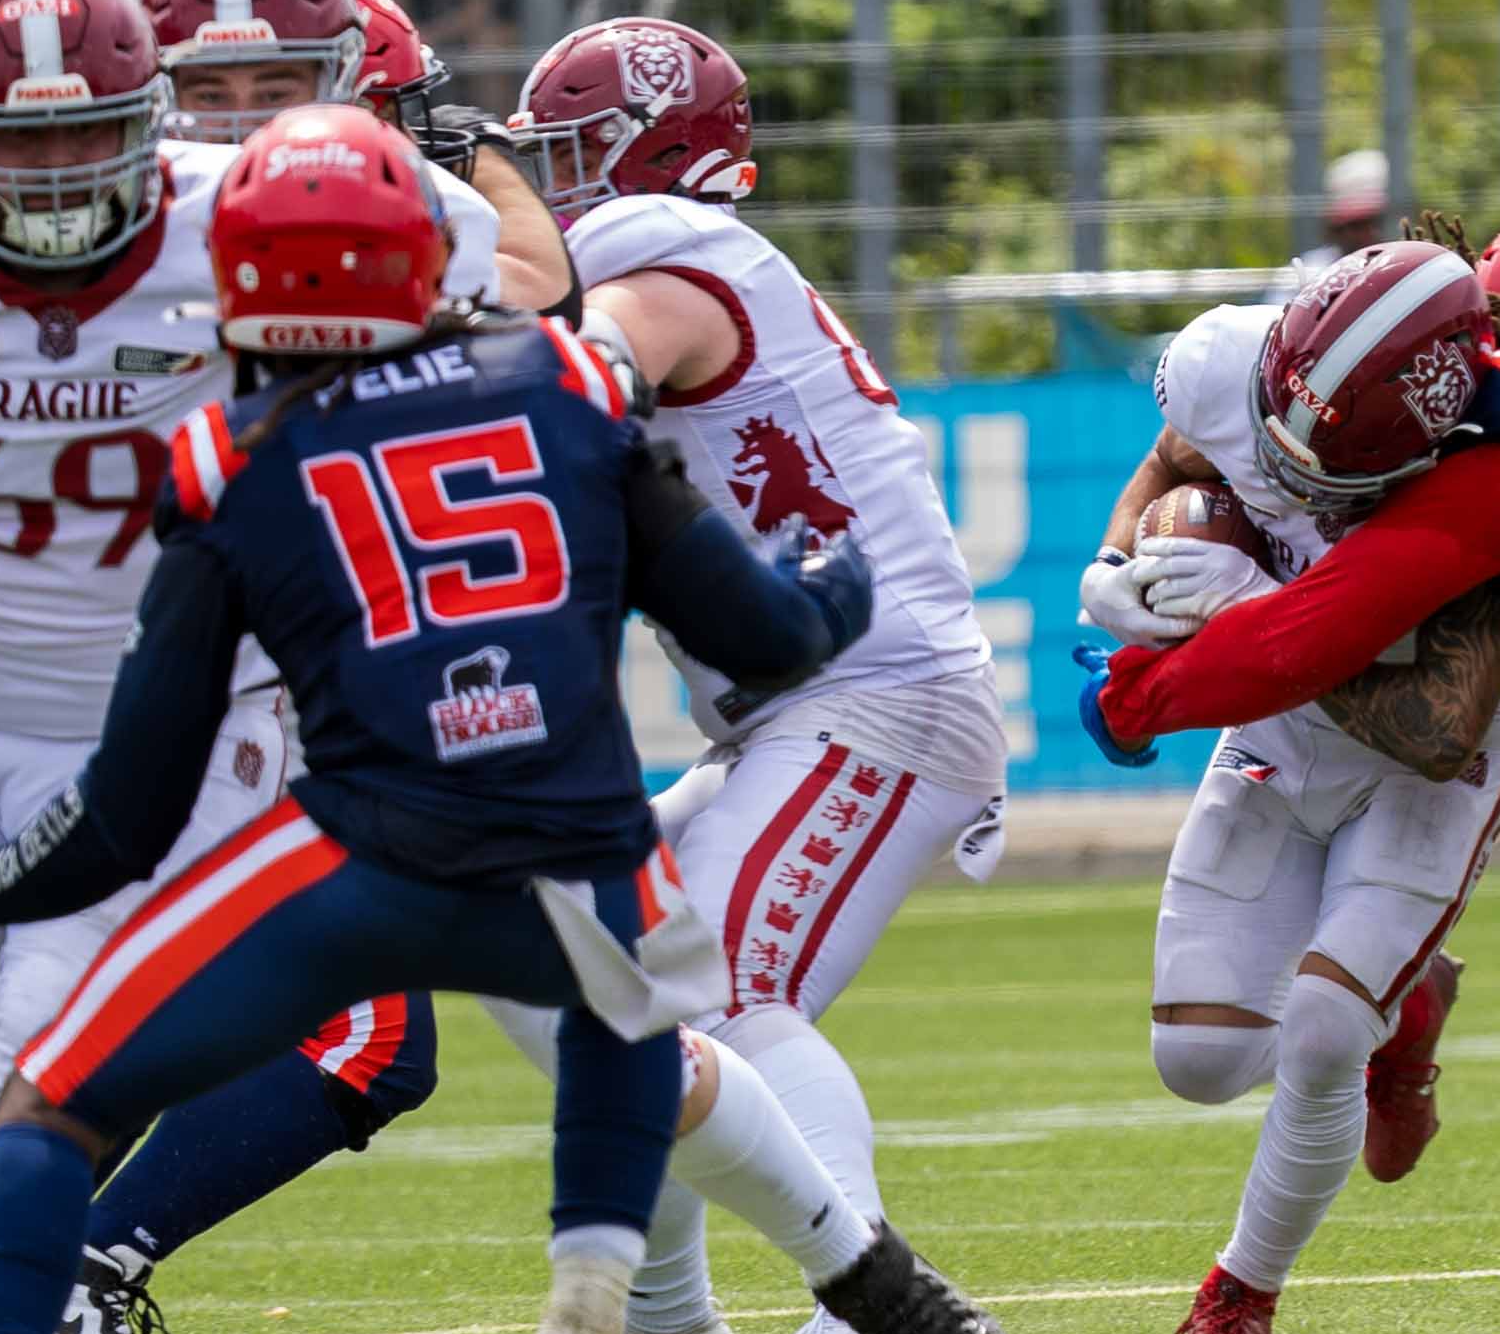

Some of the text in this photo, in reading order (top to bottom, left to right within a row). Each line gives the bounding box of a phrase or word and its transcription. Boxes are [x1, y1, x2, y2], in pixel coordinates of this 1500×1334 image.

[265, 141, 367, 182] Smile
[1287, 374, 1339, 424] GAZI
[301, 414, 571, 650] 15
